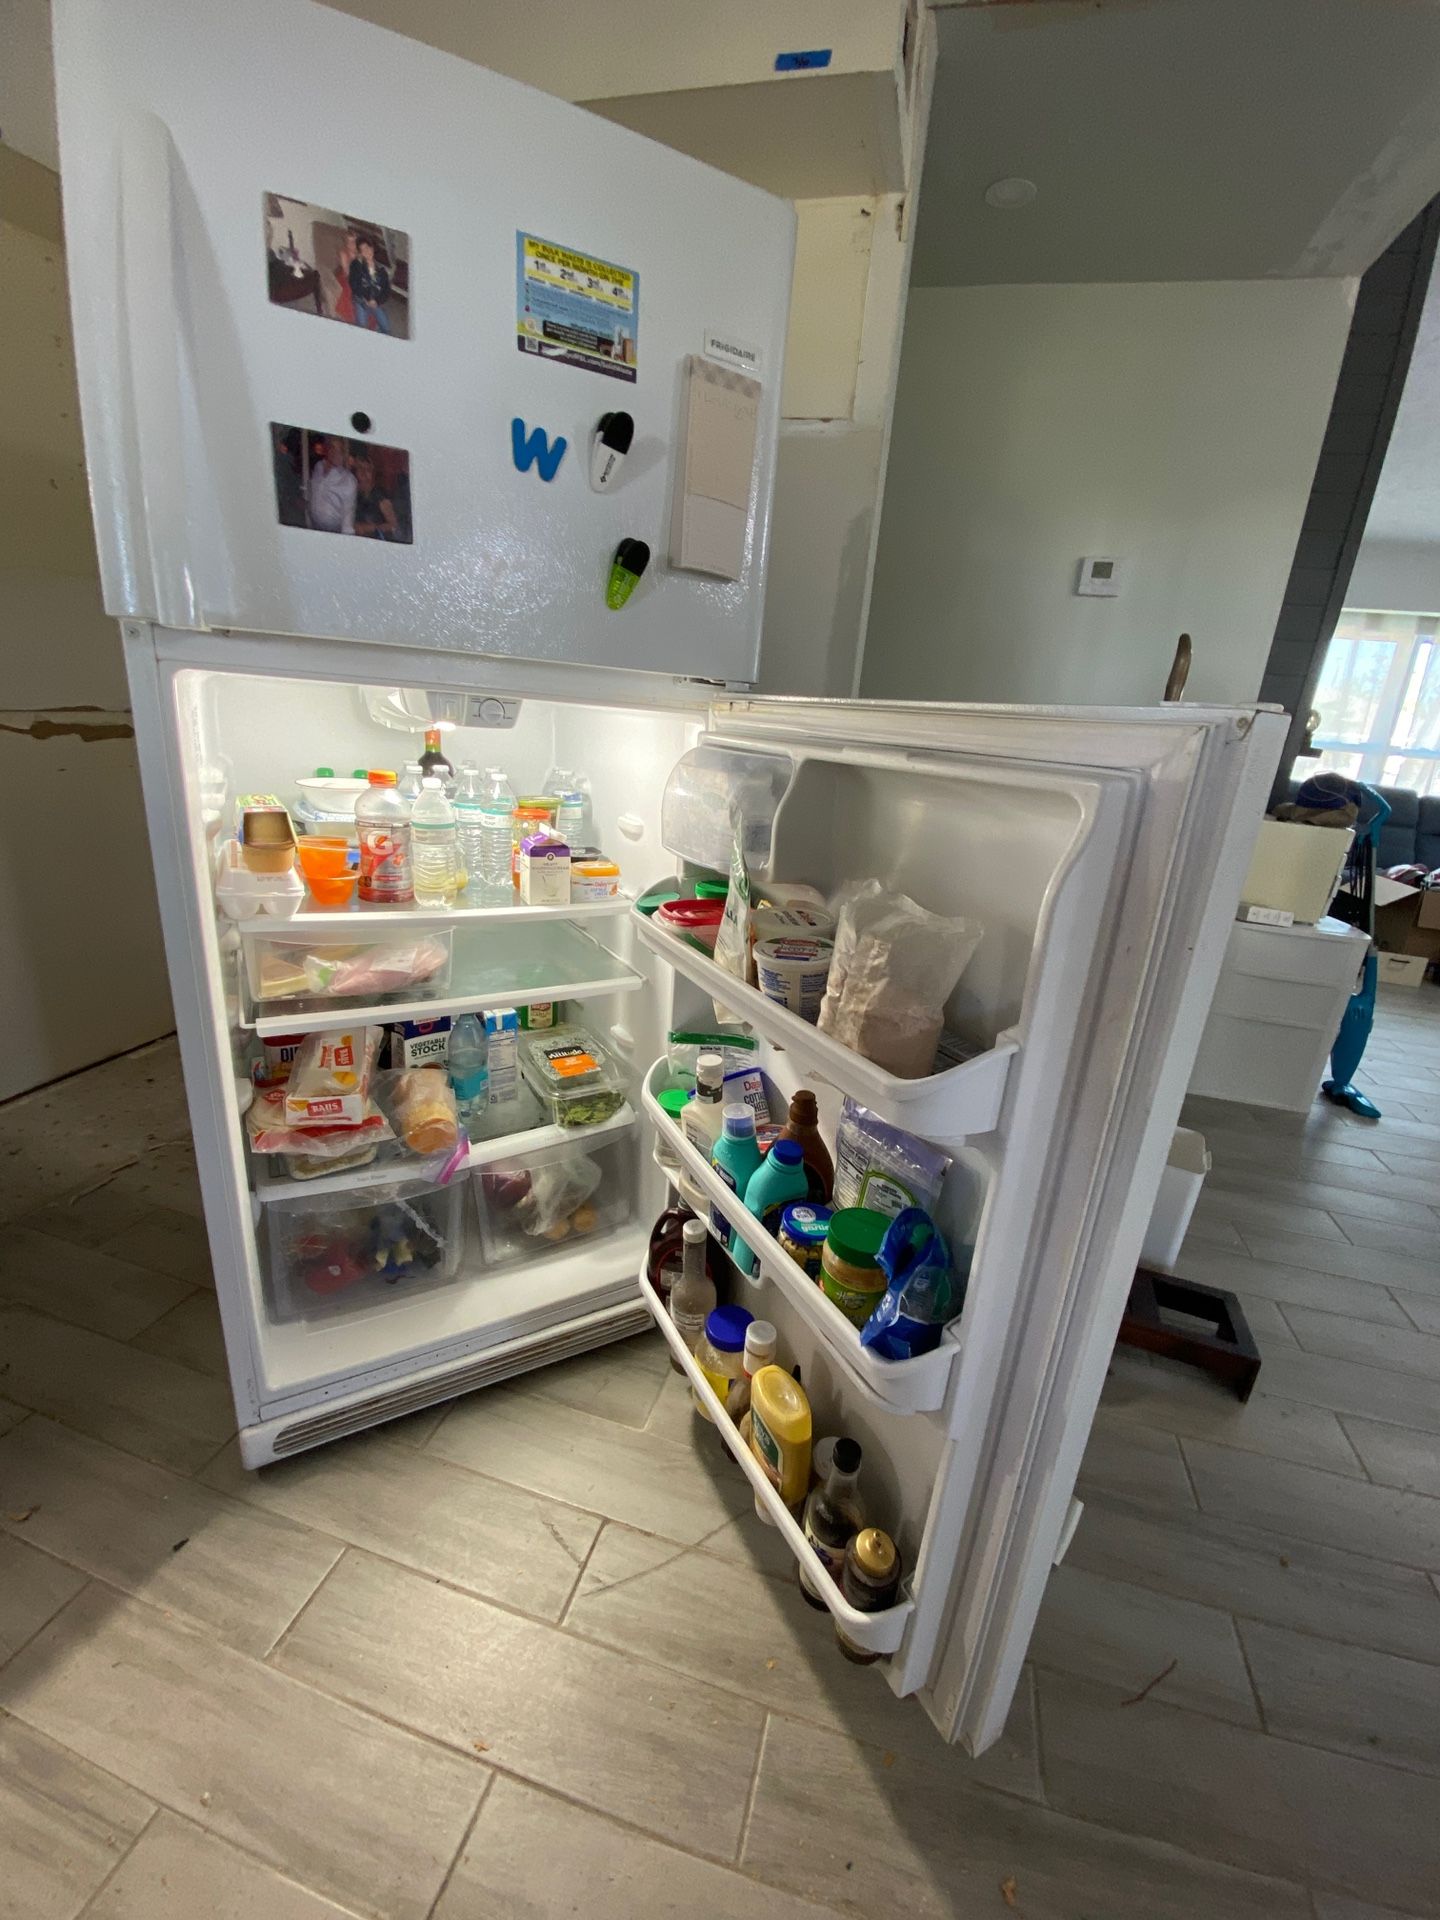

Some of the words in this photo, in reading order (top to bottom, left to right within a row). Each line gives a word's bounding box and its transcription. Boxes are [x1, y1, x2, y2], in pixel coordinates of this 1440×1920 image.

[711, 339, 756, 362] FRIGIDAIRE
[512, 417, 567, 482] W
[410, 1037, 446, 1049] VEGETABLE
[410, 1043, 446, 1057] STOCK
